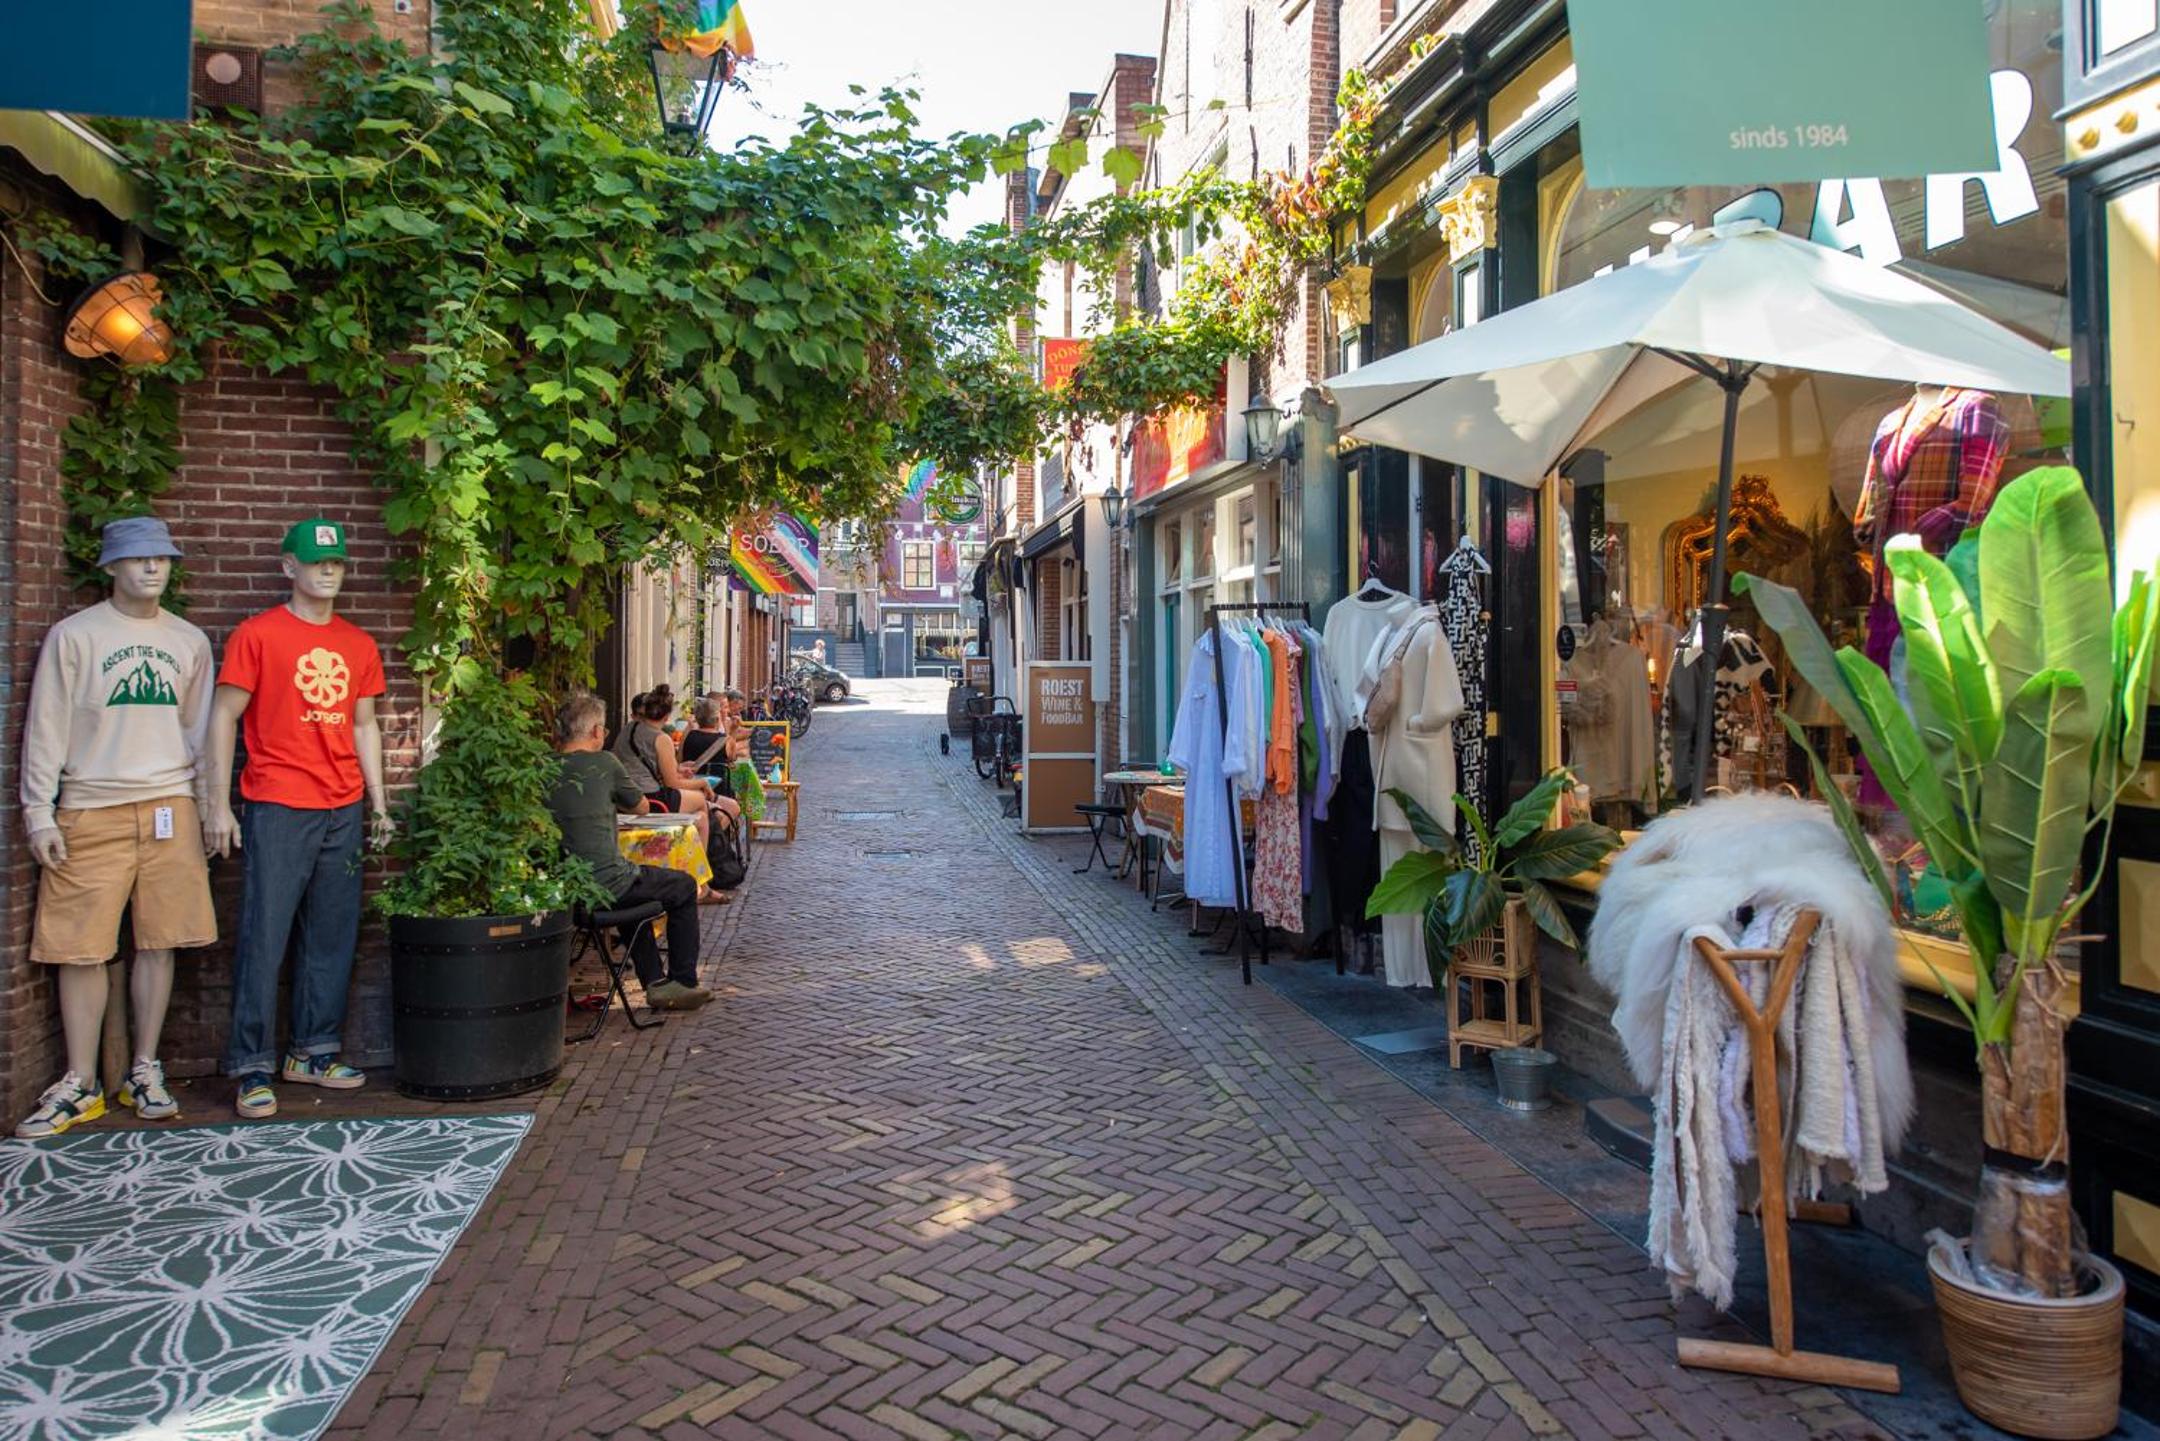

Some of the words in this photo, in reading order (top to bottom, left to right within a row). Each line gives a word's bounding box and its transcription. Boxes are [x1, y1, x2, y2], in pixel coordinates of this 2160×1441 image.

[1729, 124, 1789, 149] sinds
[1795, 124, 1848, 148] 1984
[103, 646, 134, 674] ASCENT
[137, 645, 155, 658] THE
[1041, 679, 1084, 696] ROEST
[1074, 696, 1083, 711] &
